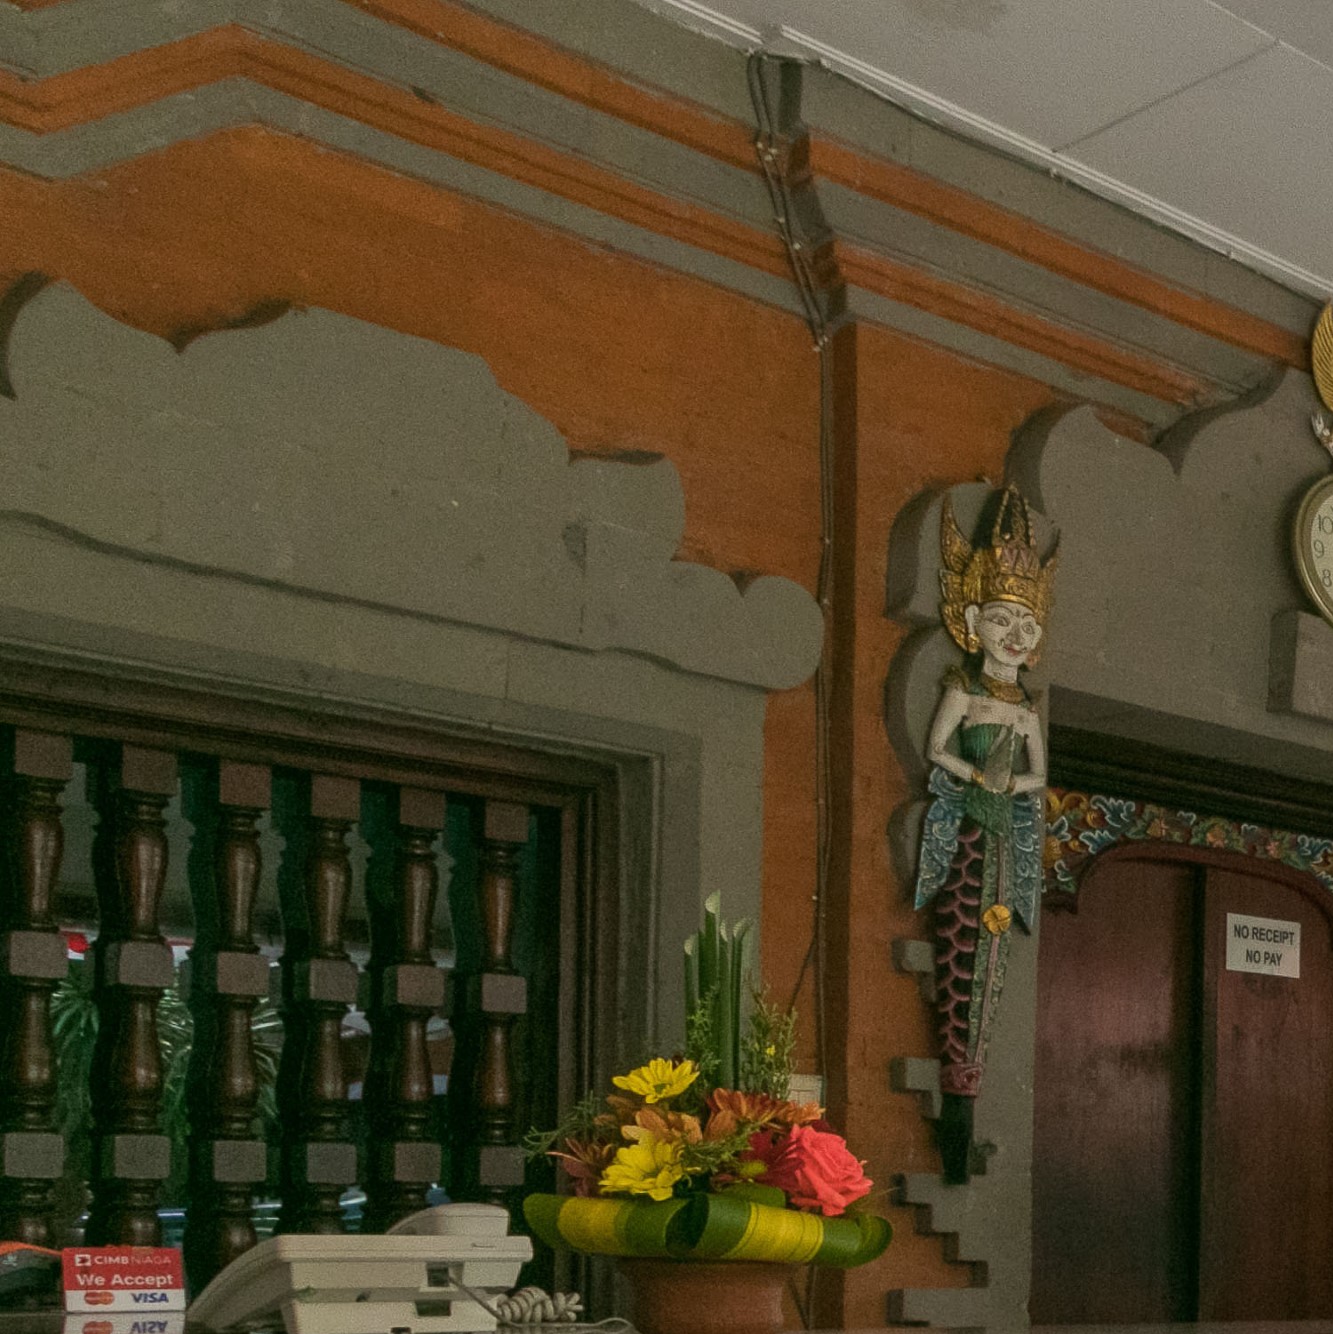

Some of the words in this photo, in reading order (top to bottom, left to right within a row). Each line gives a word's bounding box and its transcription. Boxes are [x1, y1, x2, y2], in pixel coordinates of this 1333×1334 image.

[1313, 539, 1325, 559] 9
[1321, 569, 1333, 588] 8
[1233, 924, 1249, 939] NO
[1252, 926, 1295, 946] RECEIPT
[1246, 949, 1260, 963] NO
[1263, 951, 1282, 967] PAY
[94, 1256, 129, 1265] CIMB
[130, 1256, 172, 1265] NIAGA
[76, 1274, 105, 1286] We
[111, 1274, 174, 1288] Accept
[131, 1293, 169, 1303] VISA
